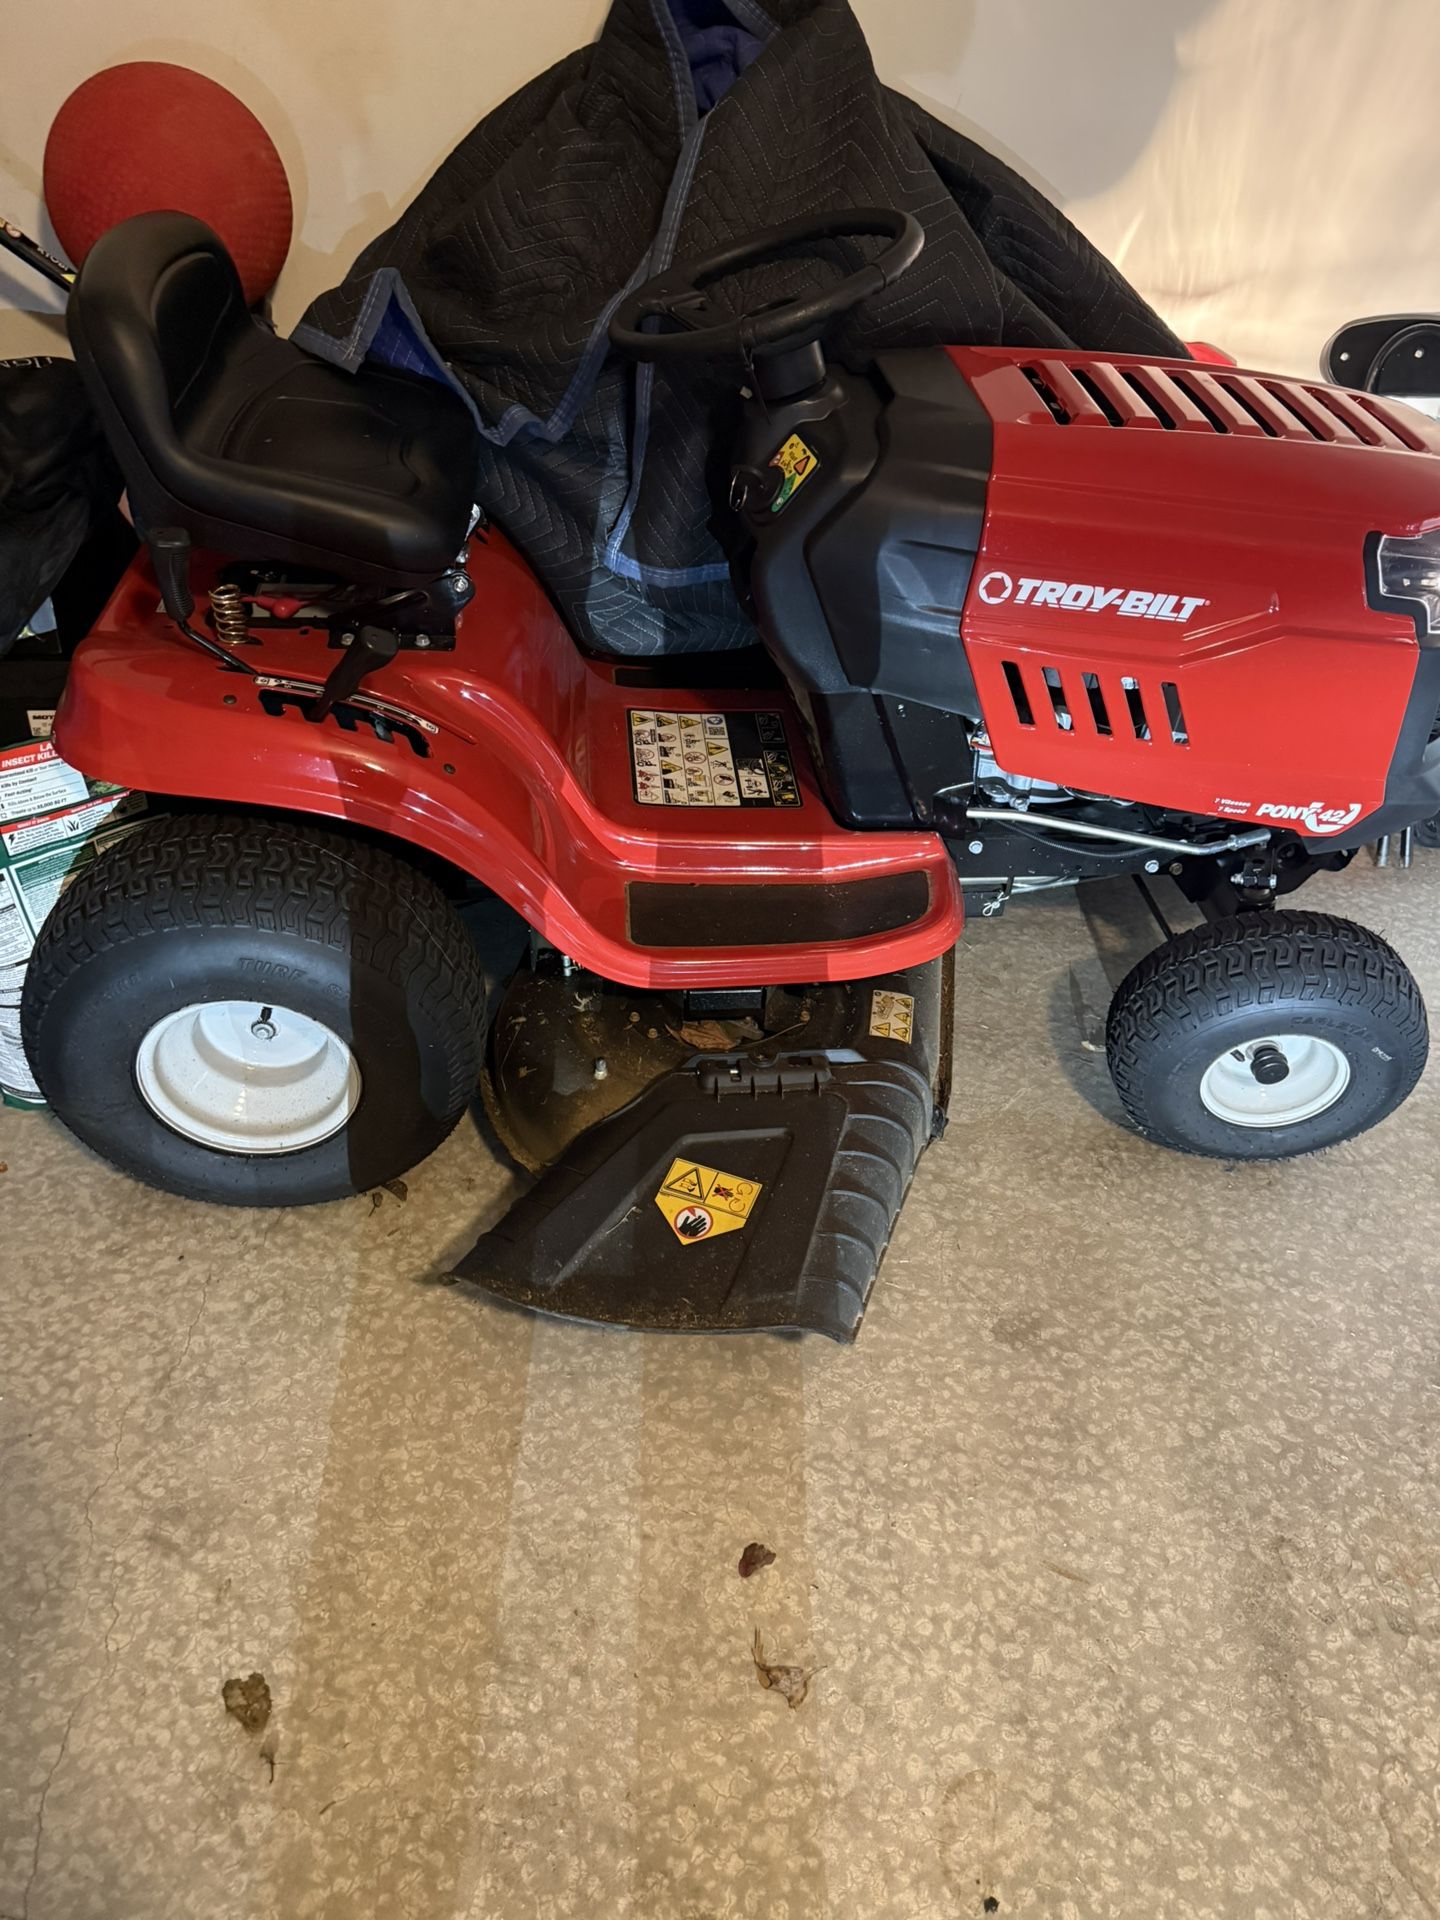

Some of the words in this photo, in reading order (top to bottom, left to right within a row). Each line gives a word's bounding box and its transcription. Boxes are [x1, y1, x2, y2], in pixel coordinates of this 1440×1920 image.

[1014, 577, 1206, 622] TROY-BILT
[2, 754, 36, 768] INSECT
[1255, 803, 1317, 820] PONY
[1318, 808, 1347, 823] 42
